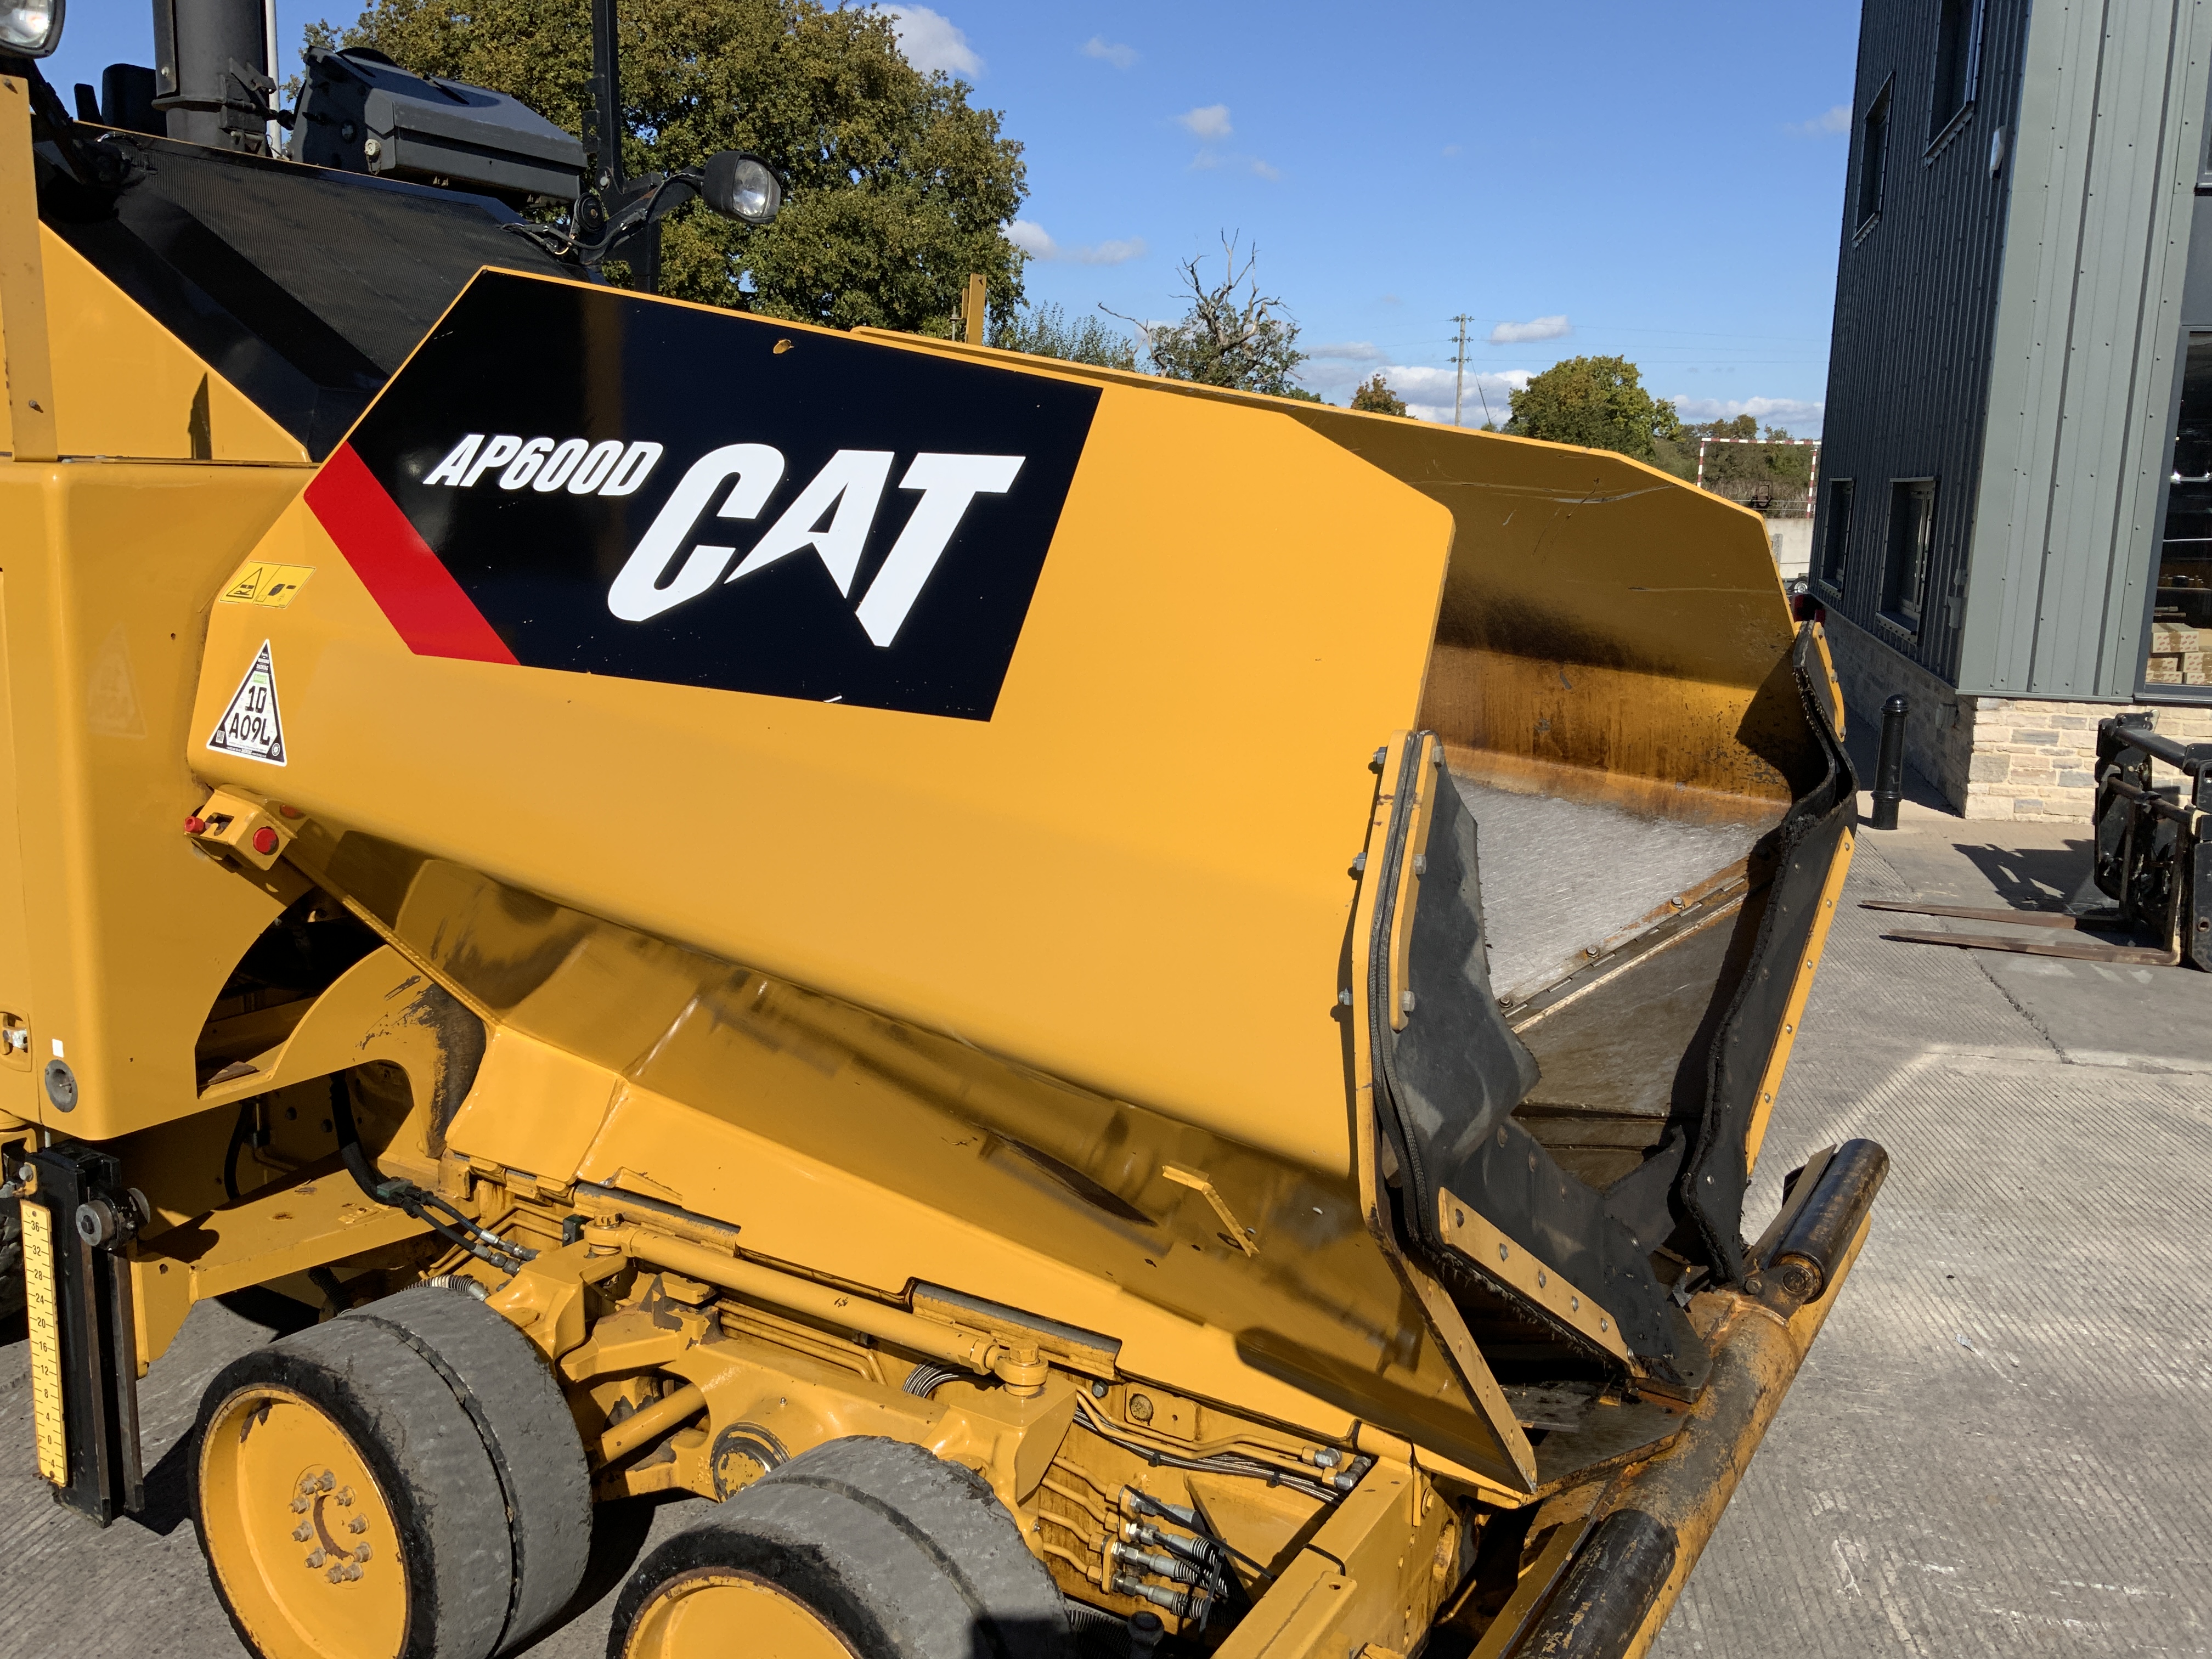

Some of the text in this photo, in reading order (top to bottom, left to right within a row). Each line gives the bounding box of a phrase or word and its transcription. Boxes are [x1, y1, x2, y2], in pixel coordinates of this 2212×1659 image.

[422, 433, 663, 496] AP600D
[607, 443, 1026, 647] CAT
[31, 1220, 40, 1232] 36
[32, 1244, 41, 1256] 32
[34, 1268, 43, 1280] 28
[36, 1293, 44, 1305] 24
[37, 1317, 46, 1329] 20
[39, 1341, 47, 1352] 16
[40, 1364, 49, 1376] 12
[44, 1389, 48, 1398] 8
[46, 1412, 50, 1421] 4
[47, 1435, 52, 1444] 0
